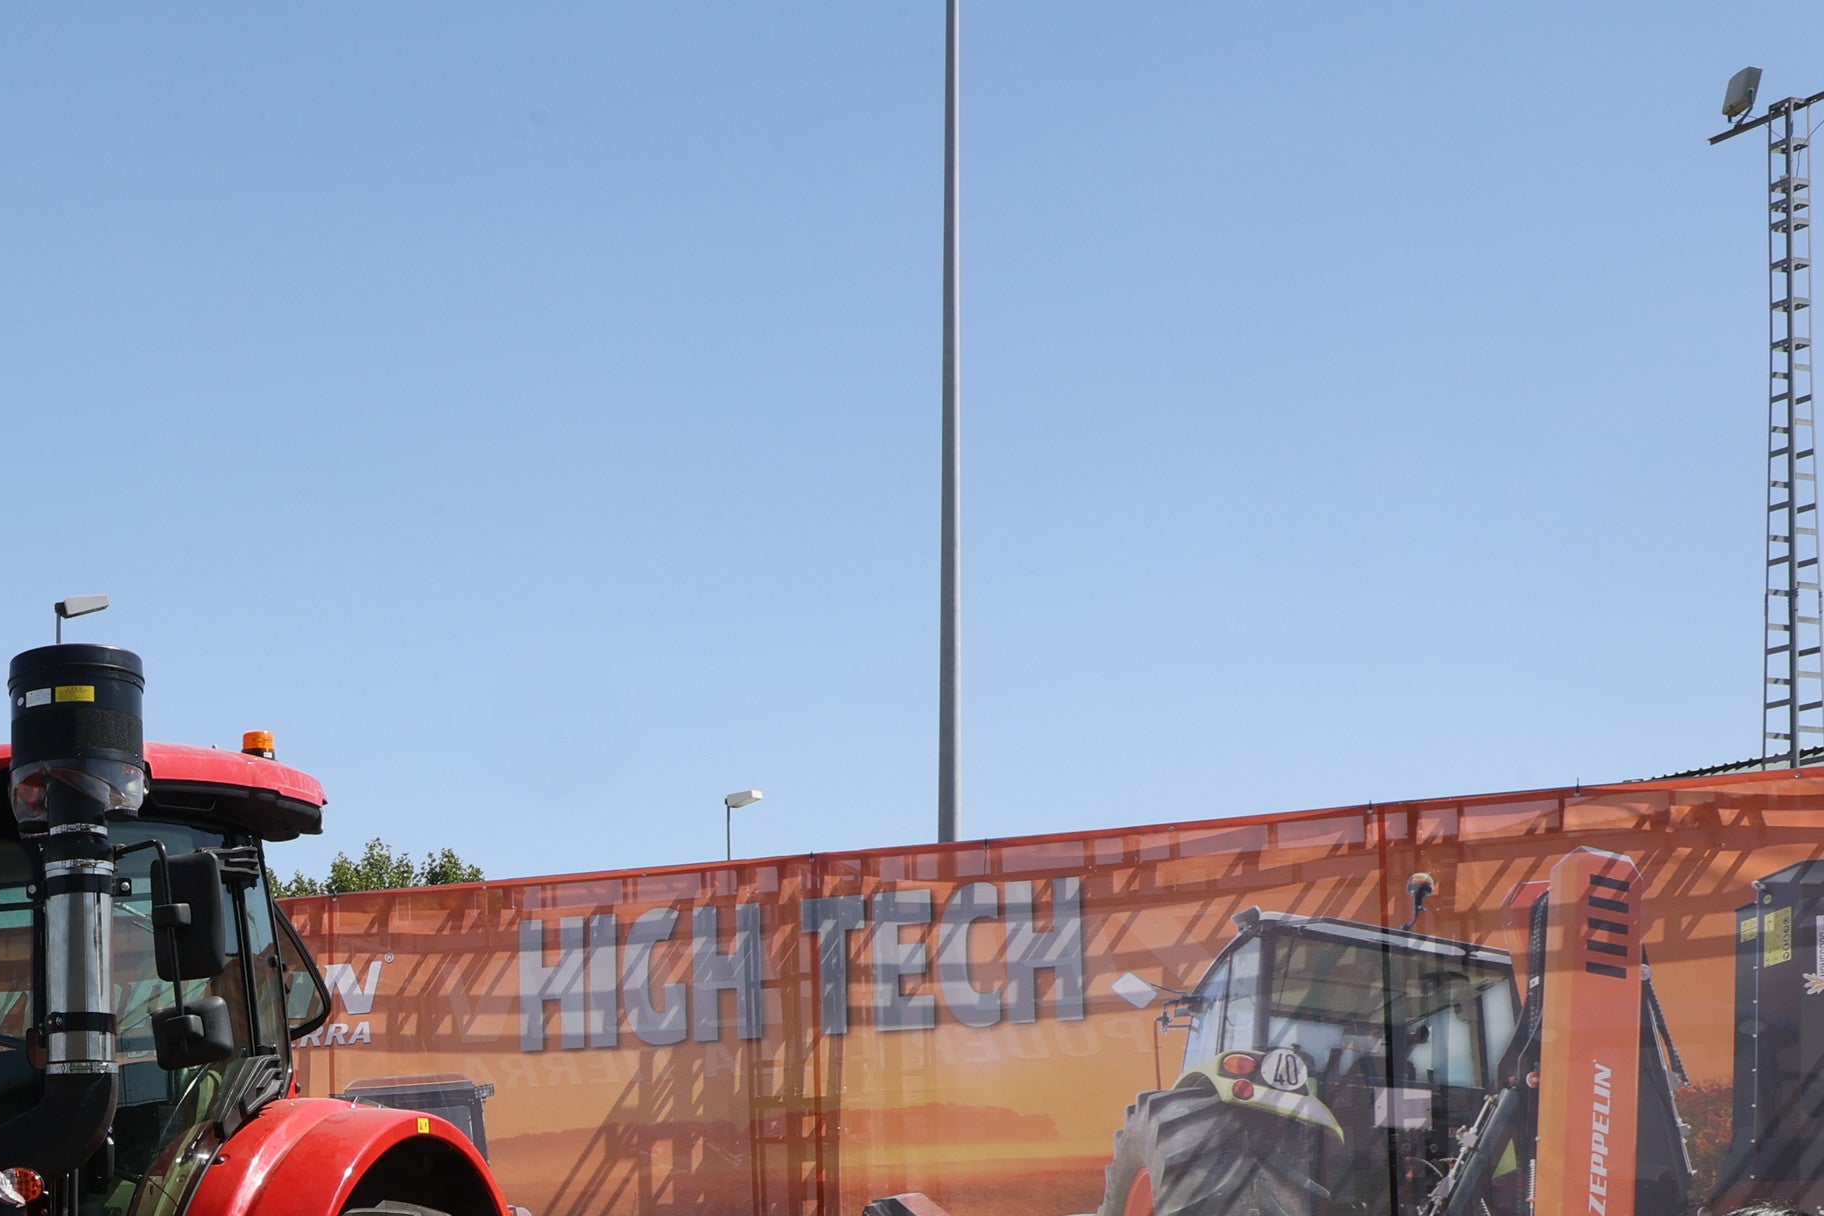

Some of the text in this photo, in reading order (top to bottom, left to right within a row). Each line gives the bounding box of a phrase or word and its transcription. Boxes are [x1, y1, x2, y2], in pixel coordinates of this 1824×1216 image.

[519, 876, 1085, 1052] HIGH TECH
[1273, 1053, 1299, 1086] 40
